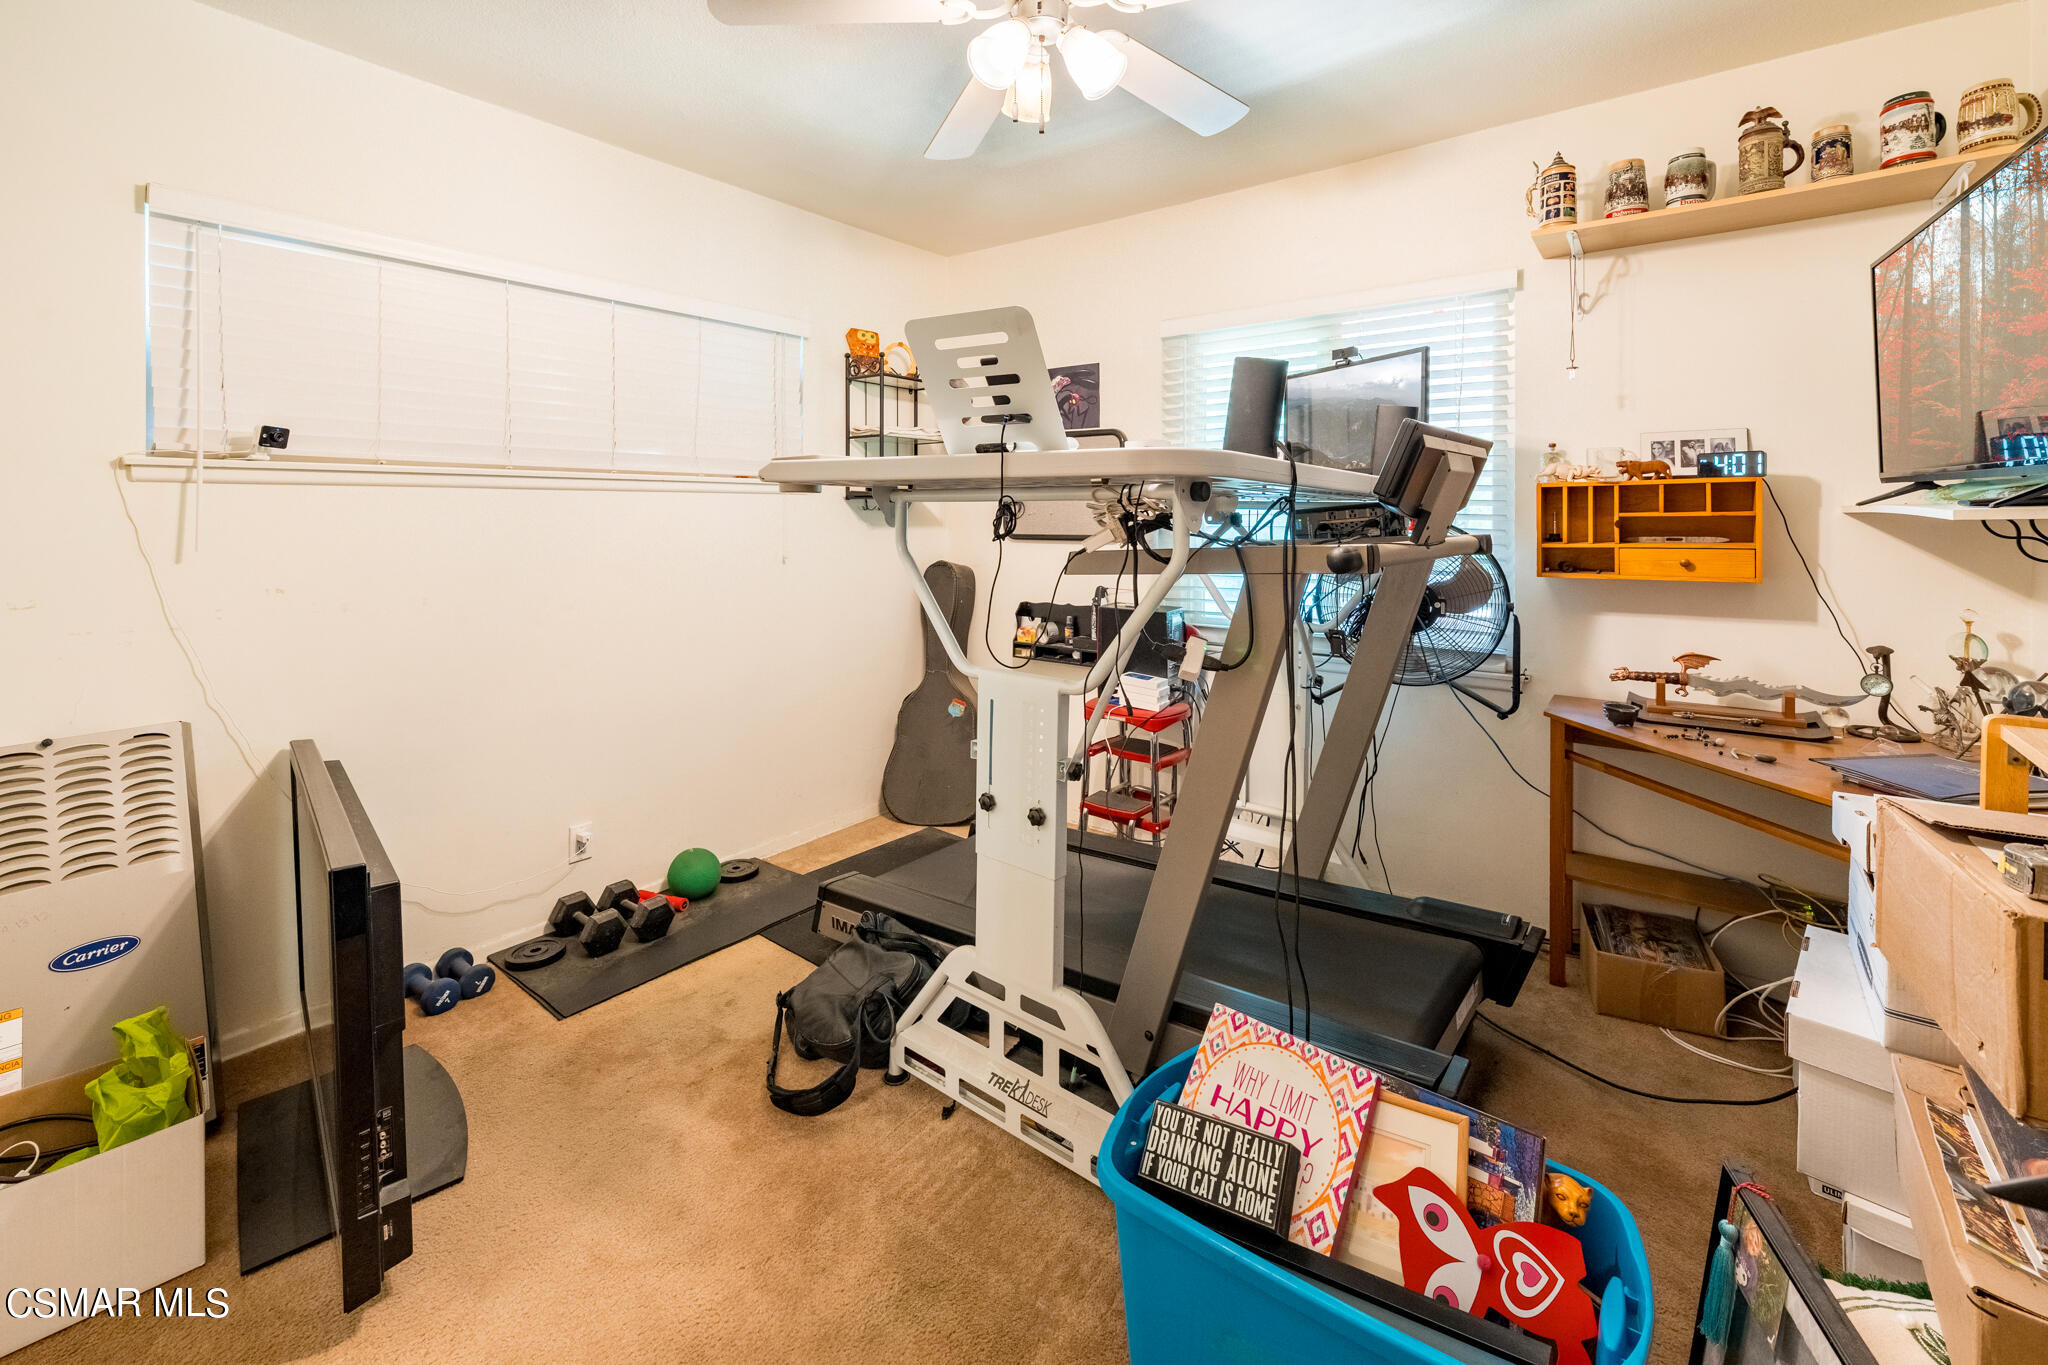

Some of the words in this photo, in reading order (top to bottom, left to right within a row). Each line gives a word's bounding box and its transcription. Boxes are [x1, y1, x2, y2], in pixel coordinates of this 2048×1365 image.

[1713, 453, 1763, 476] 4:01
[63, 940, 129, 966] Carrier
[1210, 1084, 1323, 1158] HAPPY
[1232, 1060, 1270, 1100] WHY
[1269, 1079, 1319, 1125] LIMIT
[1146, 1125, 1223, 1176] DRINKING
[1225, 1154, 1280, 1198] ALONE
[1155, 1104, 1201, 1139] YOU'RE
[1202, 1121, 1230, 1150] NOT
[1232, 1131, 1284, 1168] REALLY
[1141, 1151, 1156, 1175] IF
[1156, 1156, 1190, 1190] YOUR
[1190, 1169, 1217, 1201] CAT
[1218, 1180, 1234, 1207] IS
[1235, 1188, 1276, 1224] HOME
